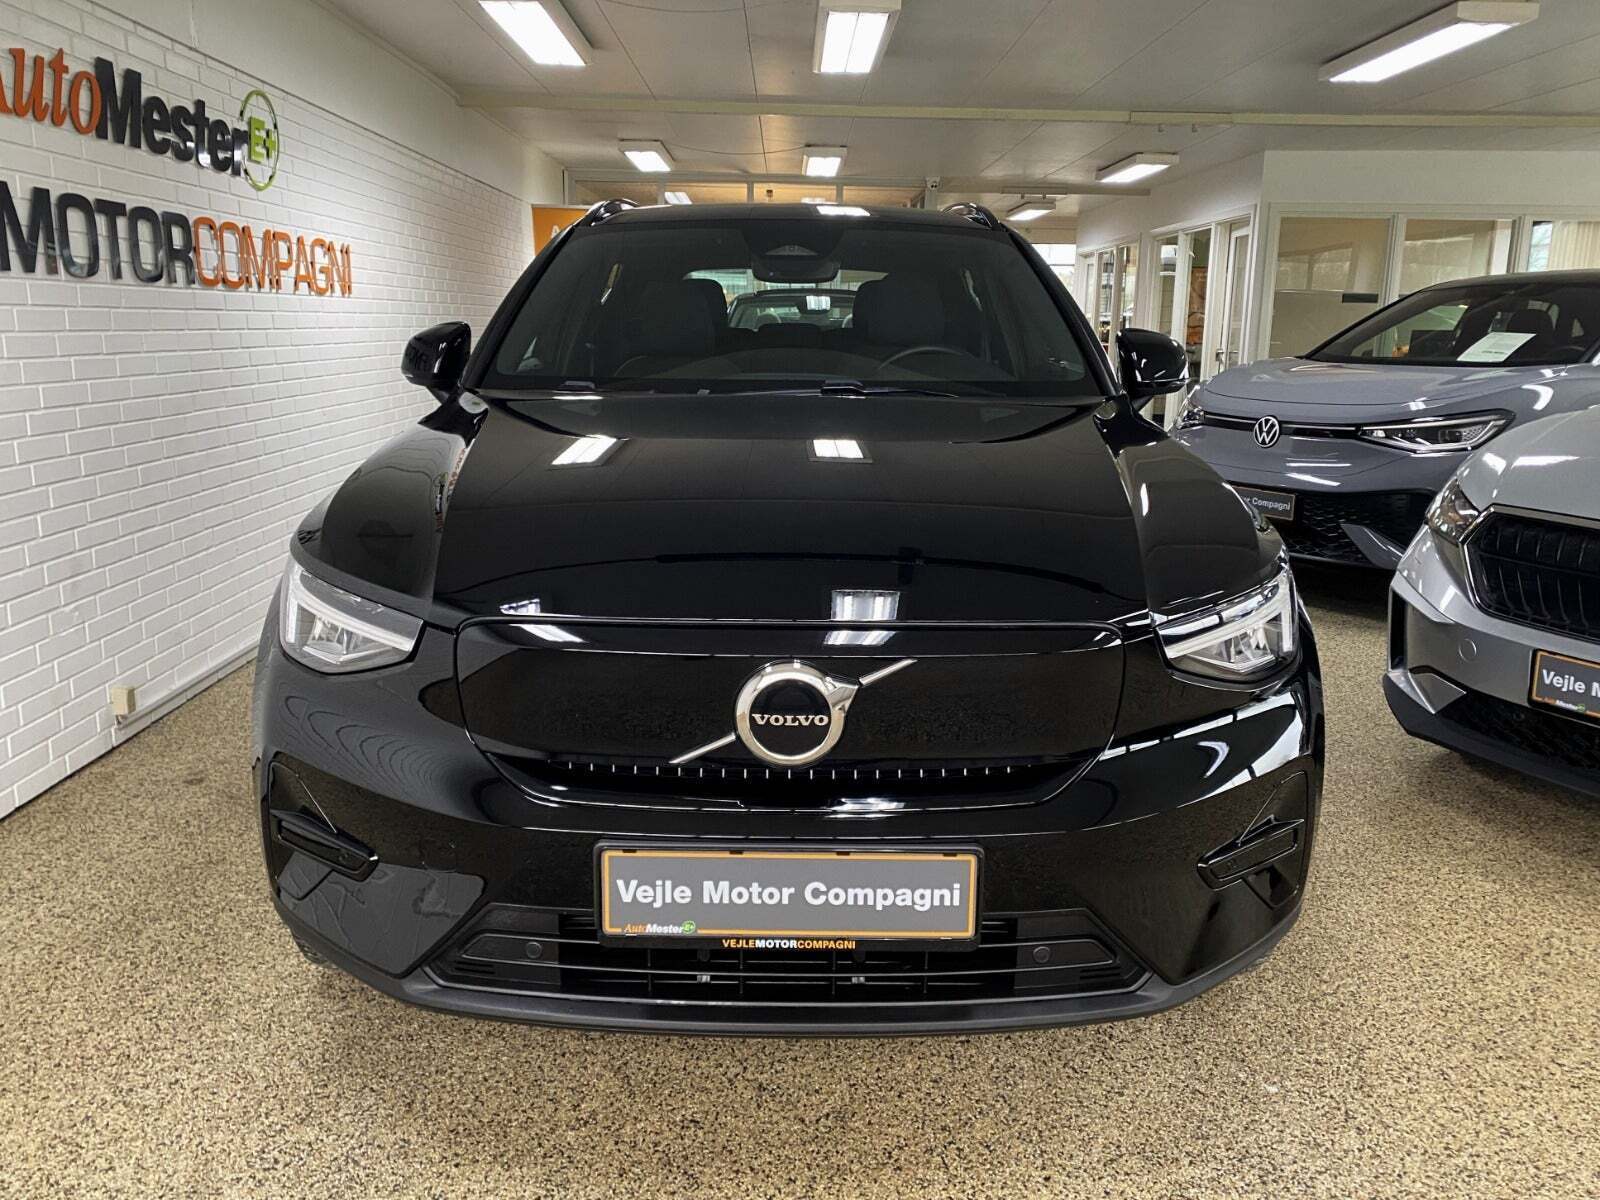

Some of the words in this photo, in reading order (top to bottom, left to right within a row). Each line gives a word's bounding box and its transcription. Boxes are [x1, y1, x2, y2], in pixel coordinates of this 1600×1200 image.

[1542, 668, 1586, 693] Vejle
[752, 713, 829, 726] VOLVO
[616, 879, 692, 908] Vejle
[702, 880, 795, 905] Motor
[804, 881, 961, 911] Compagni
